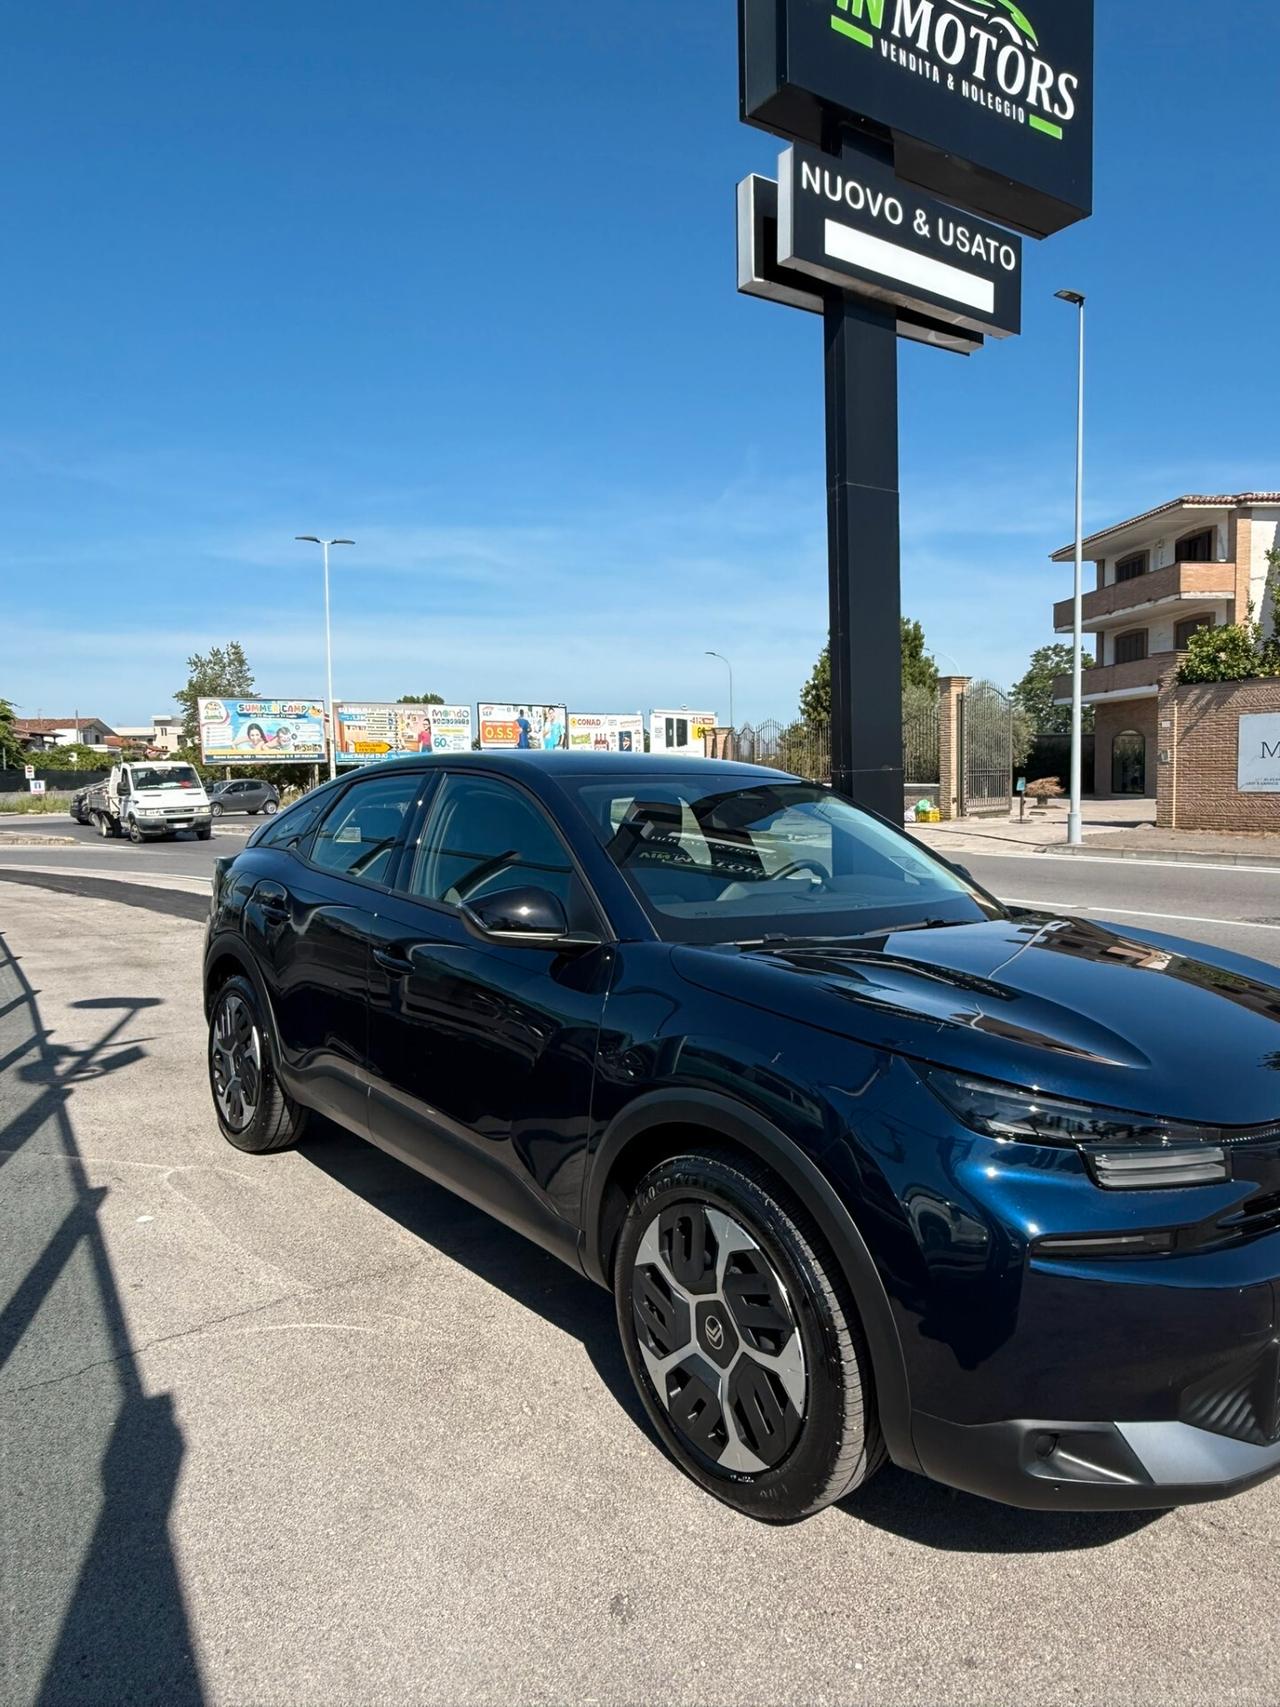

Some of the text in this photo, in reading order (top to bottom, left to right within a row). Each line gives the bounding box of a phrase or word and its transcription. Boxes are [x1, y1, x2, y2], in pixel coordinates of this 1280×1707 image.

[880, 38, 1025, 124] VENDITA & NOLEGGIO
[890, 0, 1078, 120] MOTORS
[801, 161, 1016, 271] NUOVO & USATO
[238, 704, 307, 713] SUMMER CAMP
[485, 726, 516, 738] O.S.S.
[577, 718, 601, 726] CONAD
